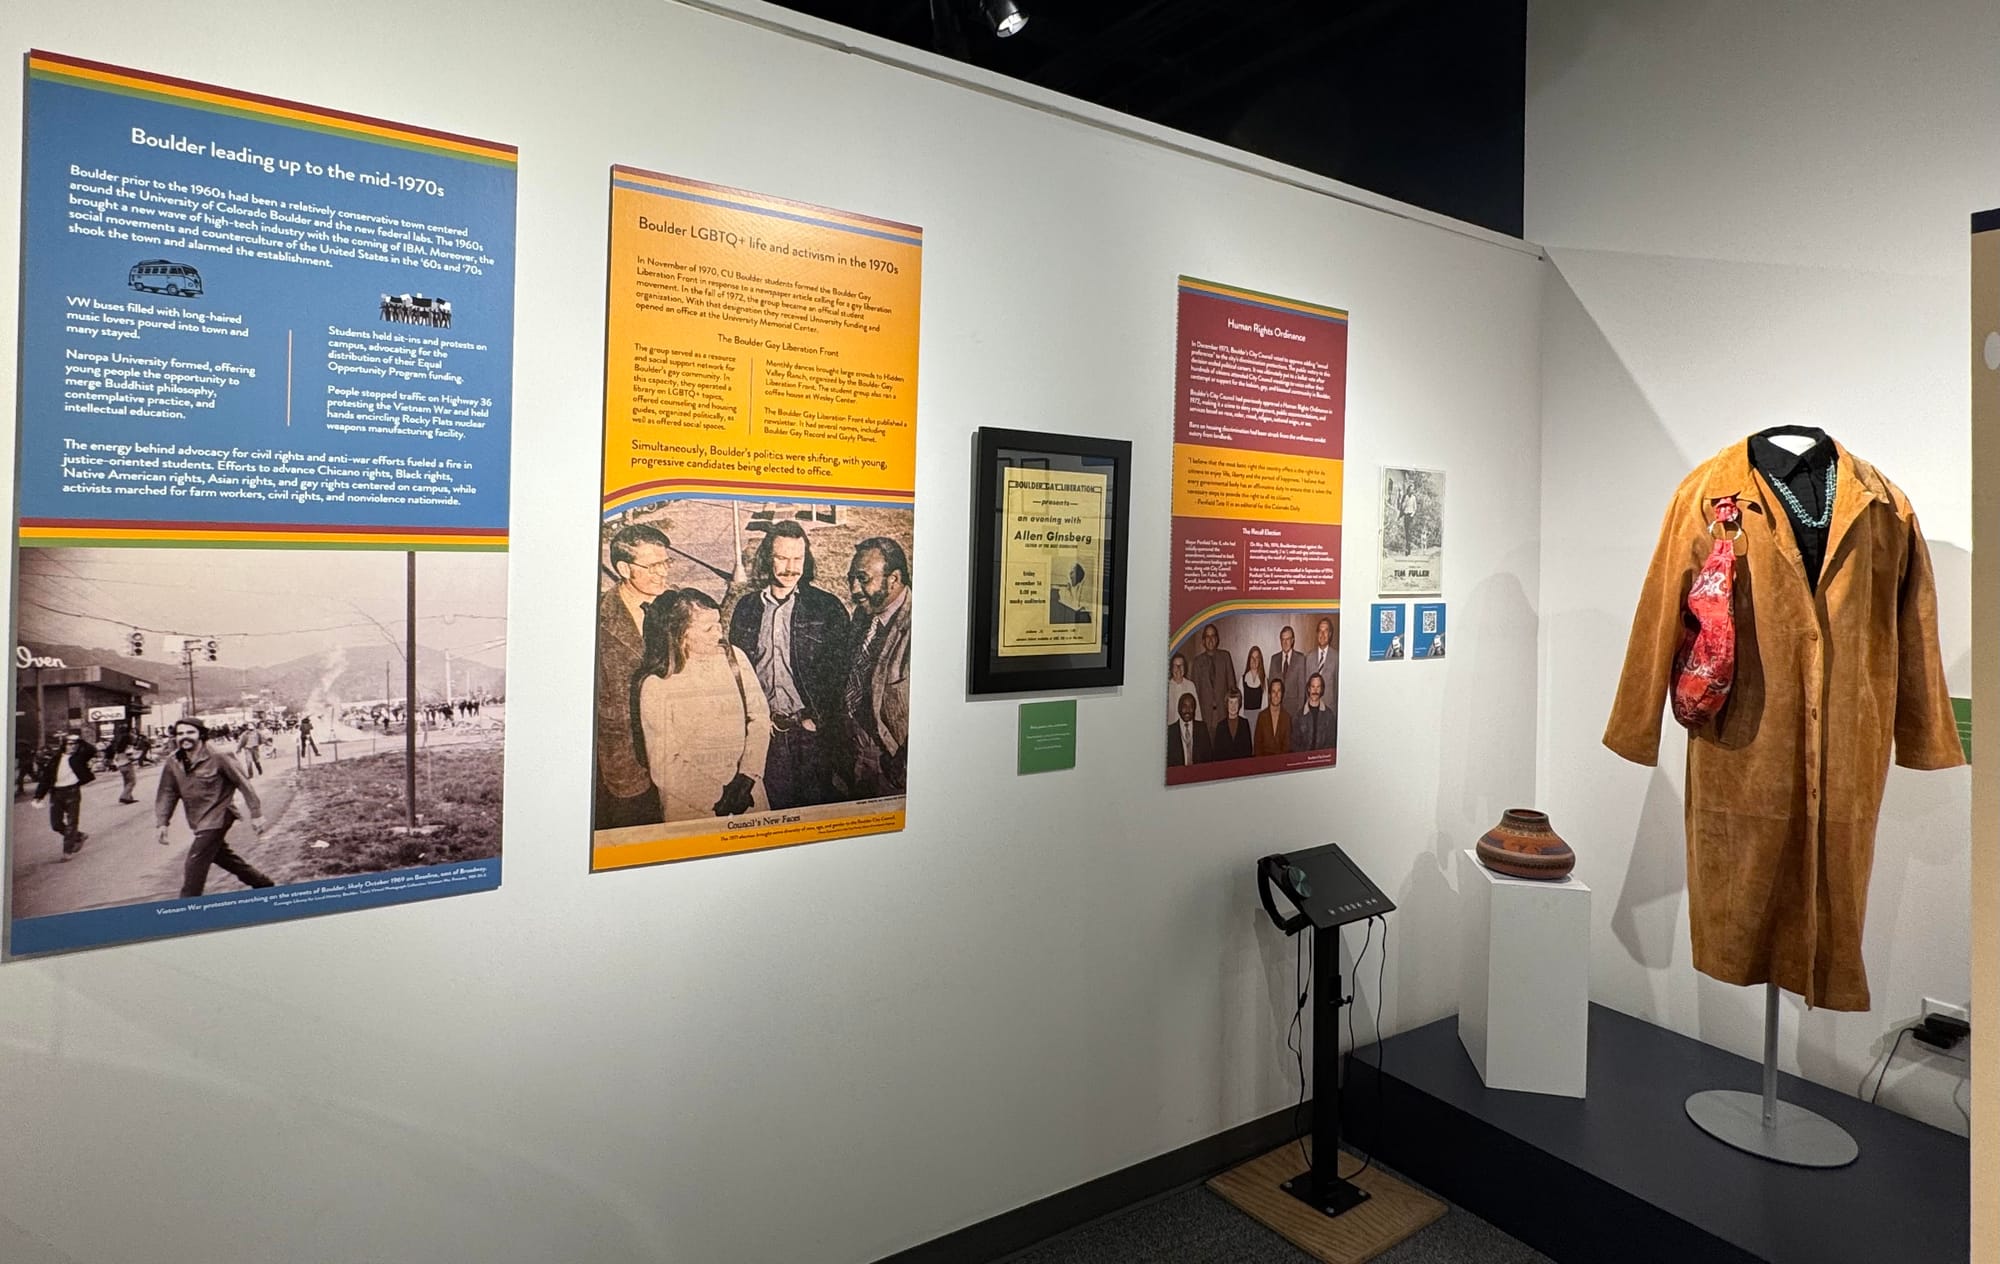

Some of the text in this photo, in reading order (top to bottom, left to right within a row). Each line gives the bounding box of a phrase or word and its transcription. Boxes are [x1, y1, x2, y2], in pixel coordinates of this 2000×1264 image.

[131, 128, 444, 197] Boulder leading up to the mid-1970s
[70, 164, 468, 237] Boulder prior to the 1960s had been a relatively conservative town centered
[69, 182, 483, 252] around the University of Colorado Boulder and the new federal labs. The 1960s
[638, 216, 898, 274] Boulder LGBTQ+ life and activism in the 1970s
[66, 295, 242, 324] VW buses filled with long-haired
[66, 311, 249, 337] music lovers poured into town and
[66, 325, 140, 341] many stayed.
[1227, 318, 1306, 342] Human Rights Ordinance
[328, 325, 487, 352] Students held sit-ins and protests on
[717, 333, 838, 358] The Boulder Gay Liberation Front
[66, 348, 256, 378] Naropa University formed, offering
[327, 384, 360, 398] People
[360, 388, 397, 401] stopped
[398, 390, 426, 402] traffic
[441, 394, 479, 409] Highway
[480, 397, 492, 407] 36
[63, 438, 87, 450] The
[89, 443, 132, 456] energy
[134, 441, 175, 455] behind
[177, 444, 230, 461] advocacy
[231, 446, 248, 458] for
[250, 448, 272, 460] civil
[274, 449, 304, 464] rights
[306, 450, 326, 462] and
[327, 452, 370, 465] anti-war
[371, 453, 405, 466] efforts
[406, 455, 436, 468] fueled
[445, 457, 462, 469] fire
[463, 458, 472, 470] in
[630, 456, 833, 476] progressive candidates being elected to office.
[631, 439, 888, 470] Simultaneously, Boulder's politics were shifting, with young,
[1015, 481, 1042, 489] BOULDER
[1061, 483, 1095, 493] LIBERATION
[1030, 515, 1062, 525] evening
[1064, 516, 1081, 524] with
[1014, 530, 1092, 544] Allen Ginsberg
[1394, 569, 1430, 577] TIM FULLER
[16, 646, 66, 669] Oven
[727, 814, 800, 830] Council's New Faces
